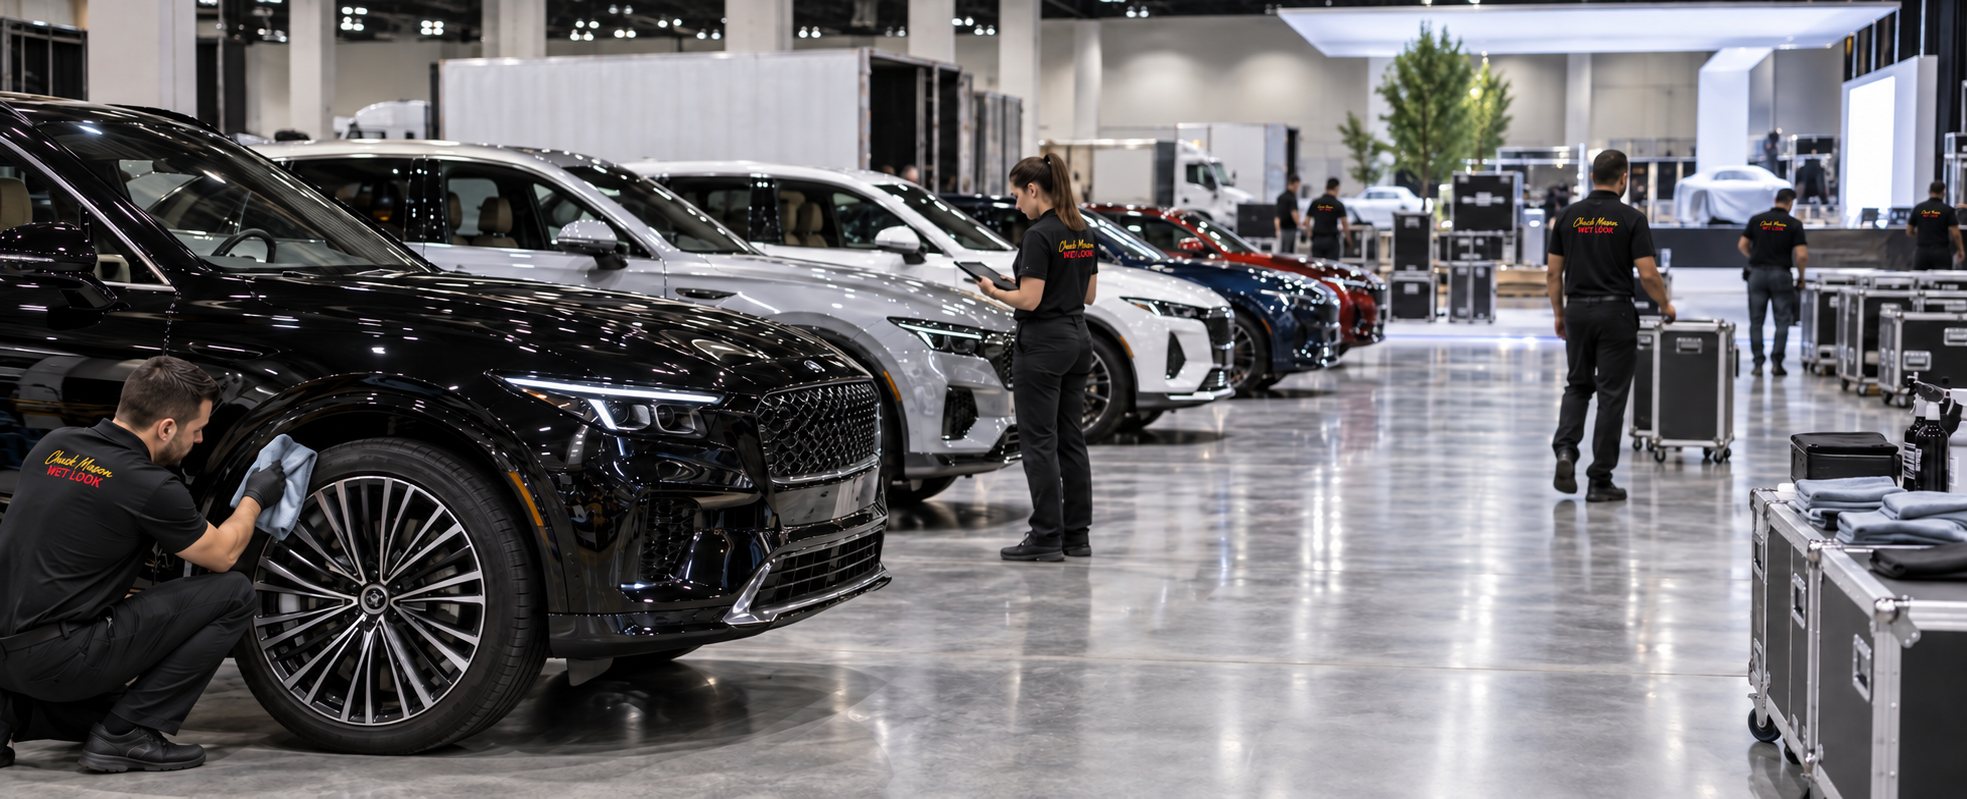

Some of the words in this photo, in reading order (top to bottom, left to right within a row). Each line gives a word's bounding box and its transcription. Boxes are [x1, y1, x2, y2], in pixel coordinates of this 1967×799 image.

[44, 449, 79, 466] Chuck
[74, 457, 113, 478] Mason
[47, 465, 70, 479] WET
[69, 470, 103, 488] LOOK
